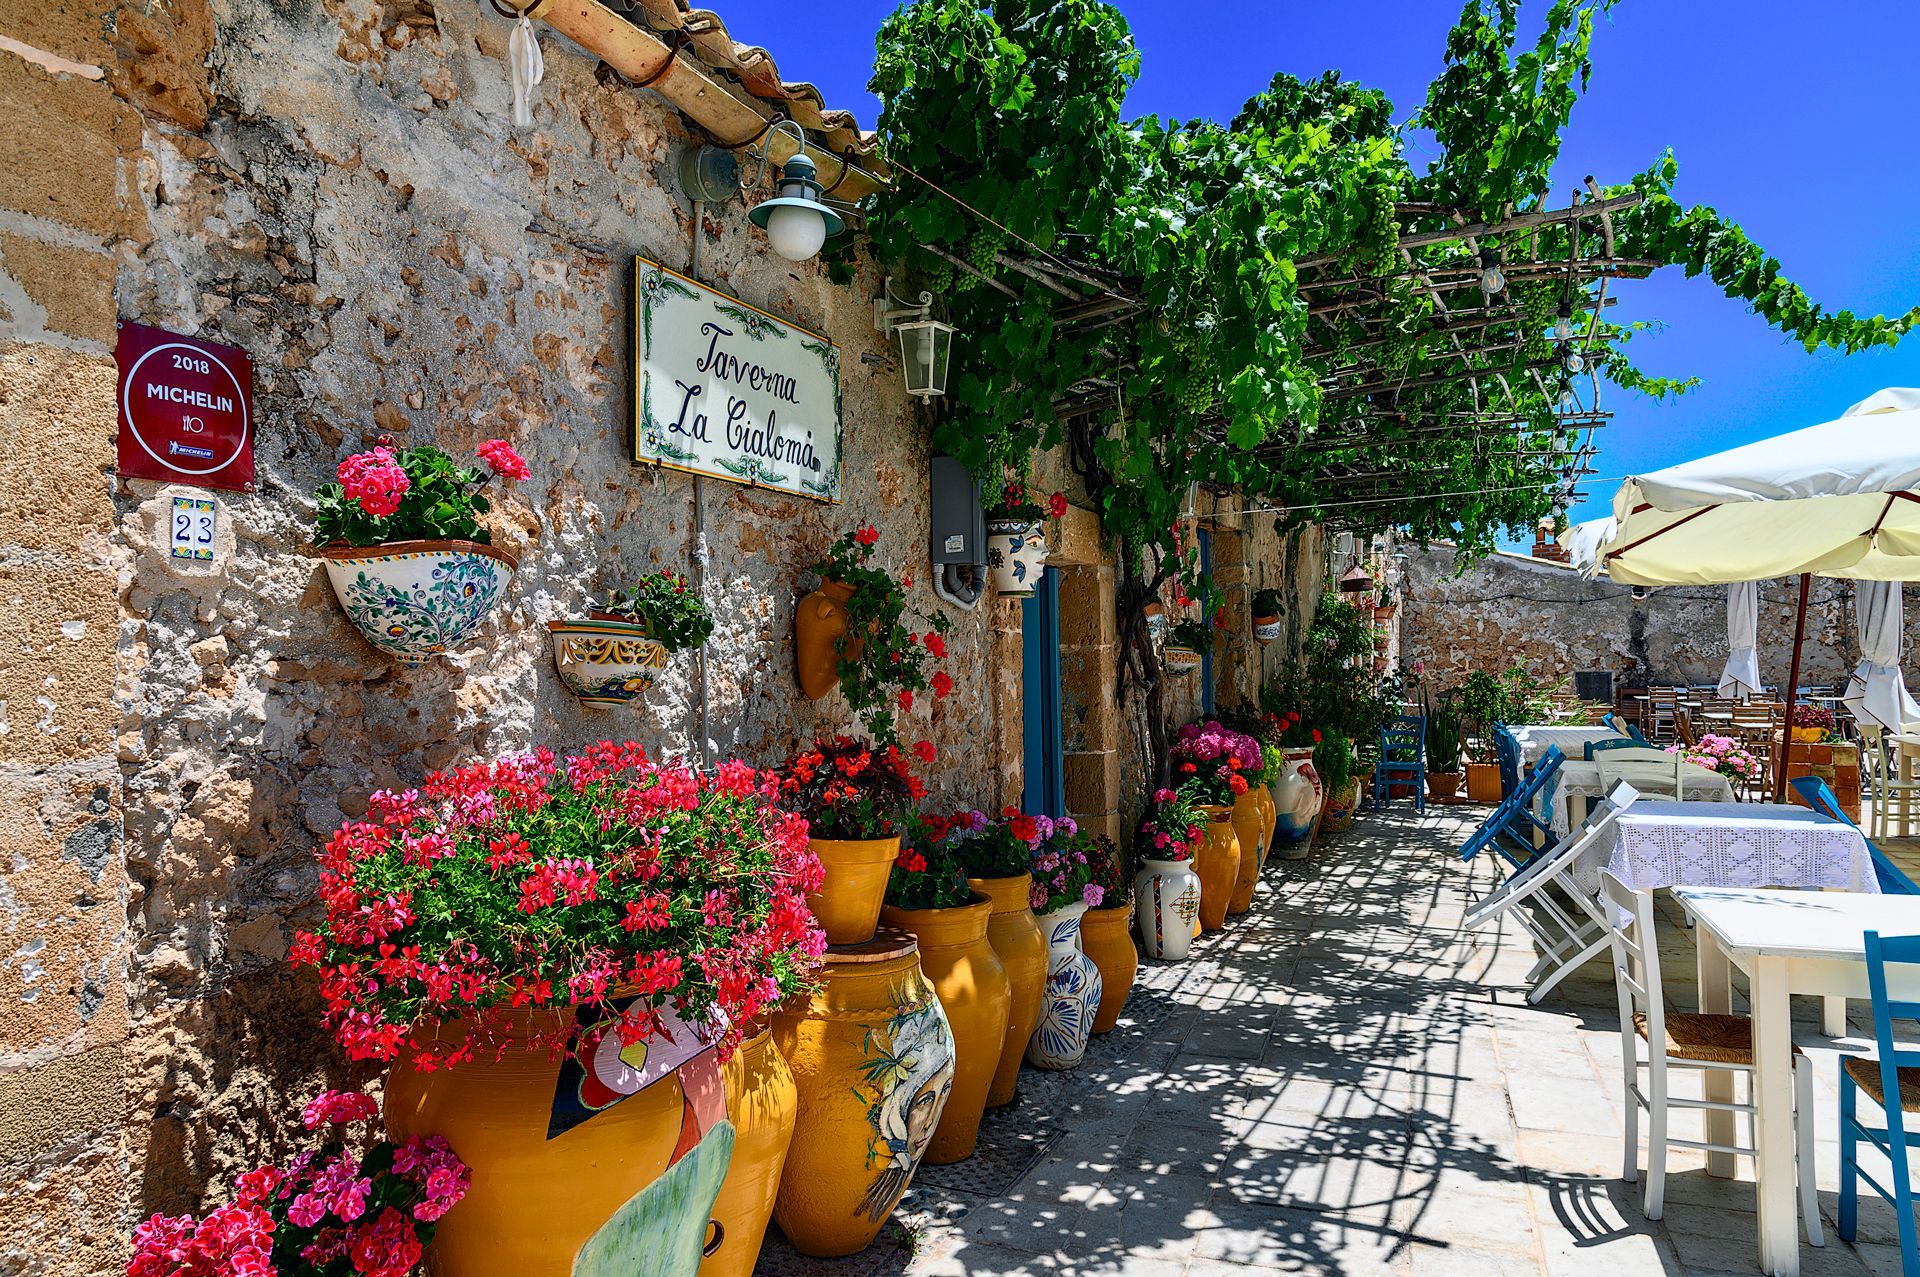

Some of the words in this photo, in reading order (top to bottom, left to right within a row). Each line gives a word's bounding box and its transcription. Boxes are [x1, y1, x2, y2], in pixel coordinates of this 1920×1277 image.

[172, 355, 210, 375] 2018
[697, 322, 800, 404] Taverna
[147, 383, 233, 413] MICHELIN
[668, 379, 712, 443] La
[178, 447, 212, 457] MICHELIN
[176, 514, 212, 543] 23
